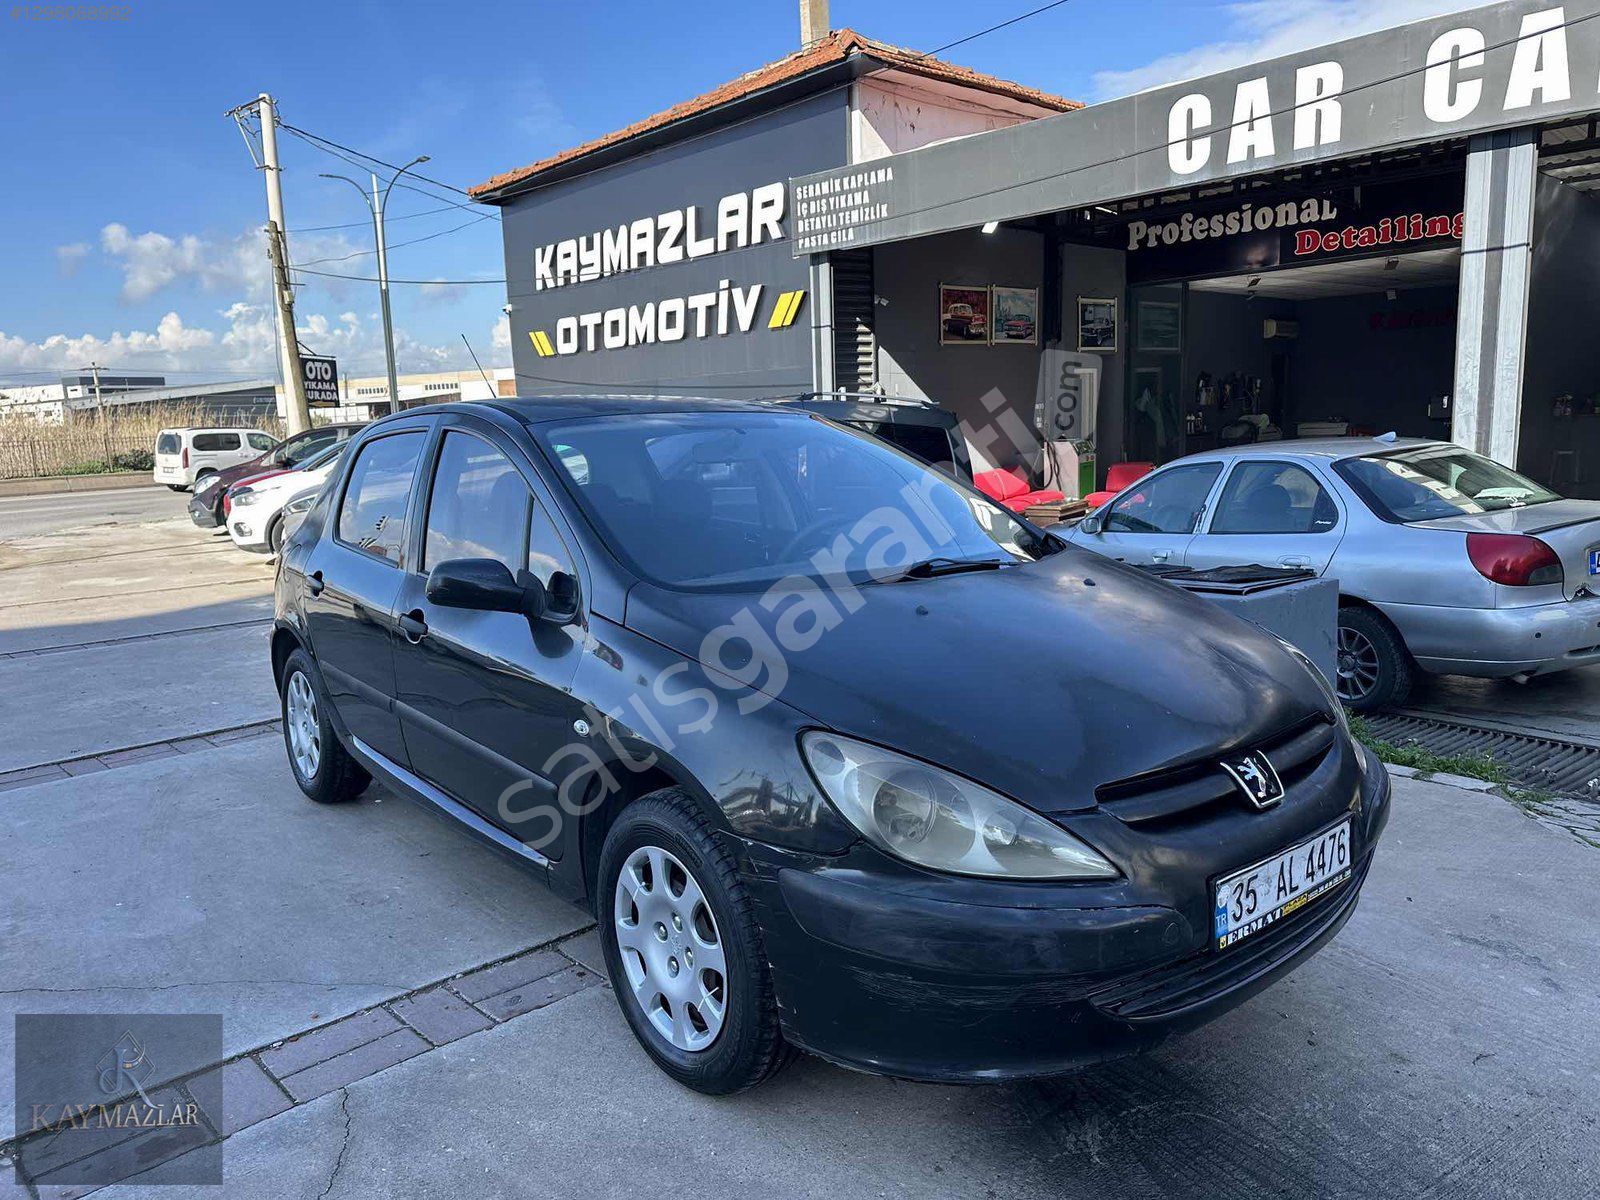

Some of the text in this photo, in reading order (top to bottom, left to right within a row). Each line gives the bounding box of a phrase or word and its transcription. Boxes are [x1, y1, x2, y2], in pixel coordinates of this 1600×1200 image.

[1167, 6, 1600, 175] CAR CA
[796, 167, 893, 200] SERAMİK KAPLAMA
[797, 201, 808, 217] İÇ
[829, 190, 870, 210] YIKAMA
[798, 203, 888, 233] DETAYLI TEMİZLİK
[535, 182, 785, 291] KAYMAZLAR
[1127, 198, 1338, 250] Professional
[798, 233, 829, 249] PASTA
[557, 279, 763, 355] OTOMOTİV
[304, 381, 336, 390] YIKAMA
[305, 361, 332, 380] OTO
[306, 390, 338, 400] URADA
[1231, 875, 1258, 922] 35
[1277, 856, 1299, 900] AL
[1305, 828, 1346, 882] 4476
[1216, 914, 1227, 926] TR
